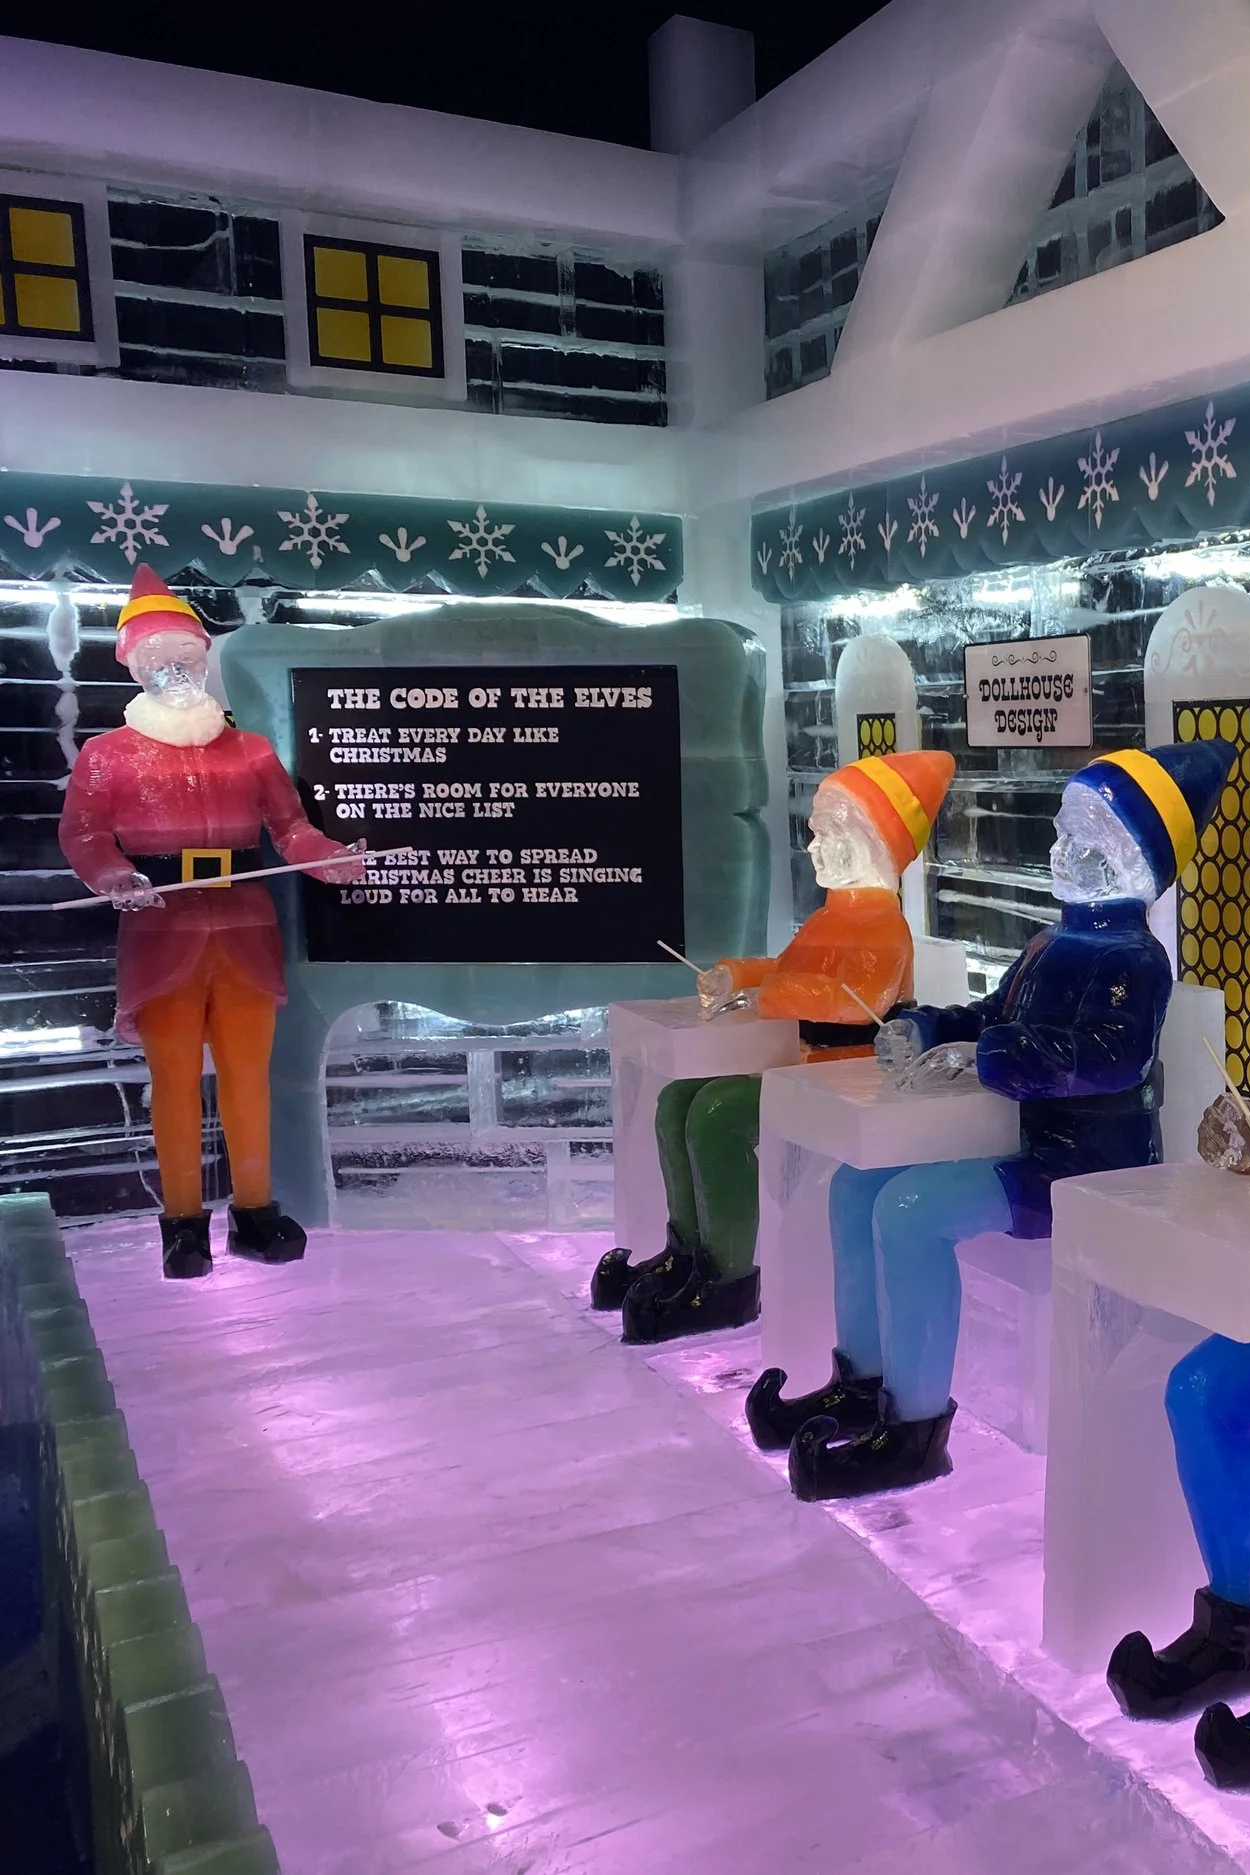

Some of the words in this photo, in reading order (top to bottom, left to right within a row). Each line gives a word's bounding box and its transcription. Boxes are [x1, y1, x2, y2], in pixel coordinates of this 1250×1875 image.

[979, 673, 1074, 702] DOLLHOUSE
[327, 688, 381, 710] THE
[389, 688, 459, 710] CODE
[468, 688, 501, 709] OF
[510, 687, 564, 709] THE
[574, 686, 653, 709] ELVES
[994, 708, 1058, 743] DESIGN
[328, 727, 392, 744] TREAT
[397, 727, 460, 744] EVERY
[467, 727, 507, 744] DAY
[512, 727, 560, 743] LIKE
[329, 747, 448, 764] CHRISTMAS
[334, 783, 416, 800] THERE'S
[421, 783, 482, 799] ROOM
[489, 783, 529, 799] FOR
[535, 781, 641, 798] EVERYONE
[335, 803, 366, 820] ON
[372, 803, 413, 819] THE
[418, 802, 466, 819] NICE
[472, 802, 516, 818] LIST
[384, 849, 431, 866] BEST
[437, 849, 480, 866] WAY
[486, 849, 514, 865] TO
[520, 848, 598, 865] SPREAD
[461, 868, 527, 885] CHEER
[532, 868, 552, 884] IS
[559, 867, 643, 884] SINGING
[340, 888, 393, 905] LOUD
[400, 888, 438, 904] FOR
[444, 888, 482, 904] ALL
[488, 888, 516, 903] TO
[522, 887, 579, 903] HEAR
